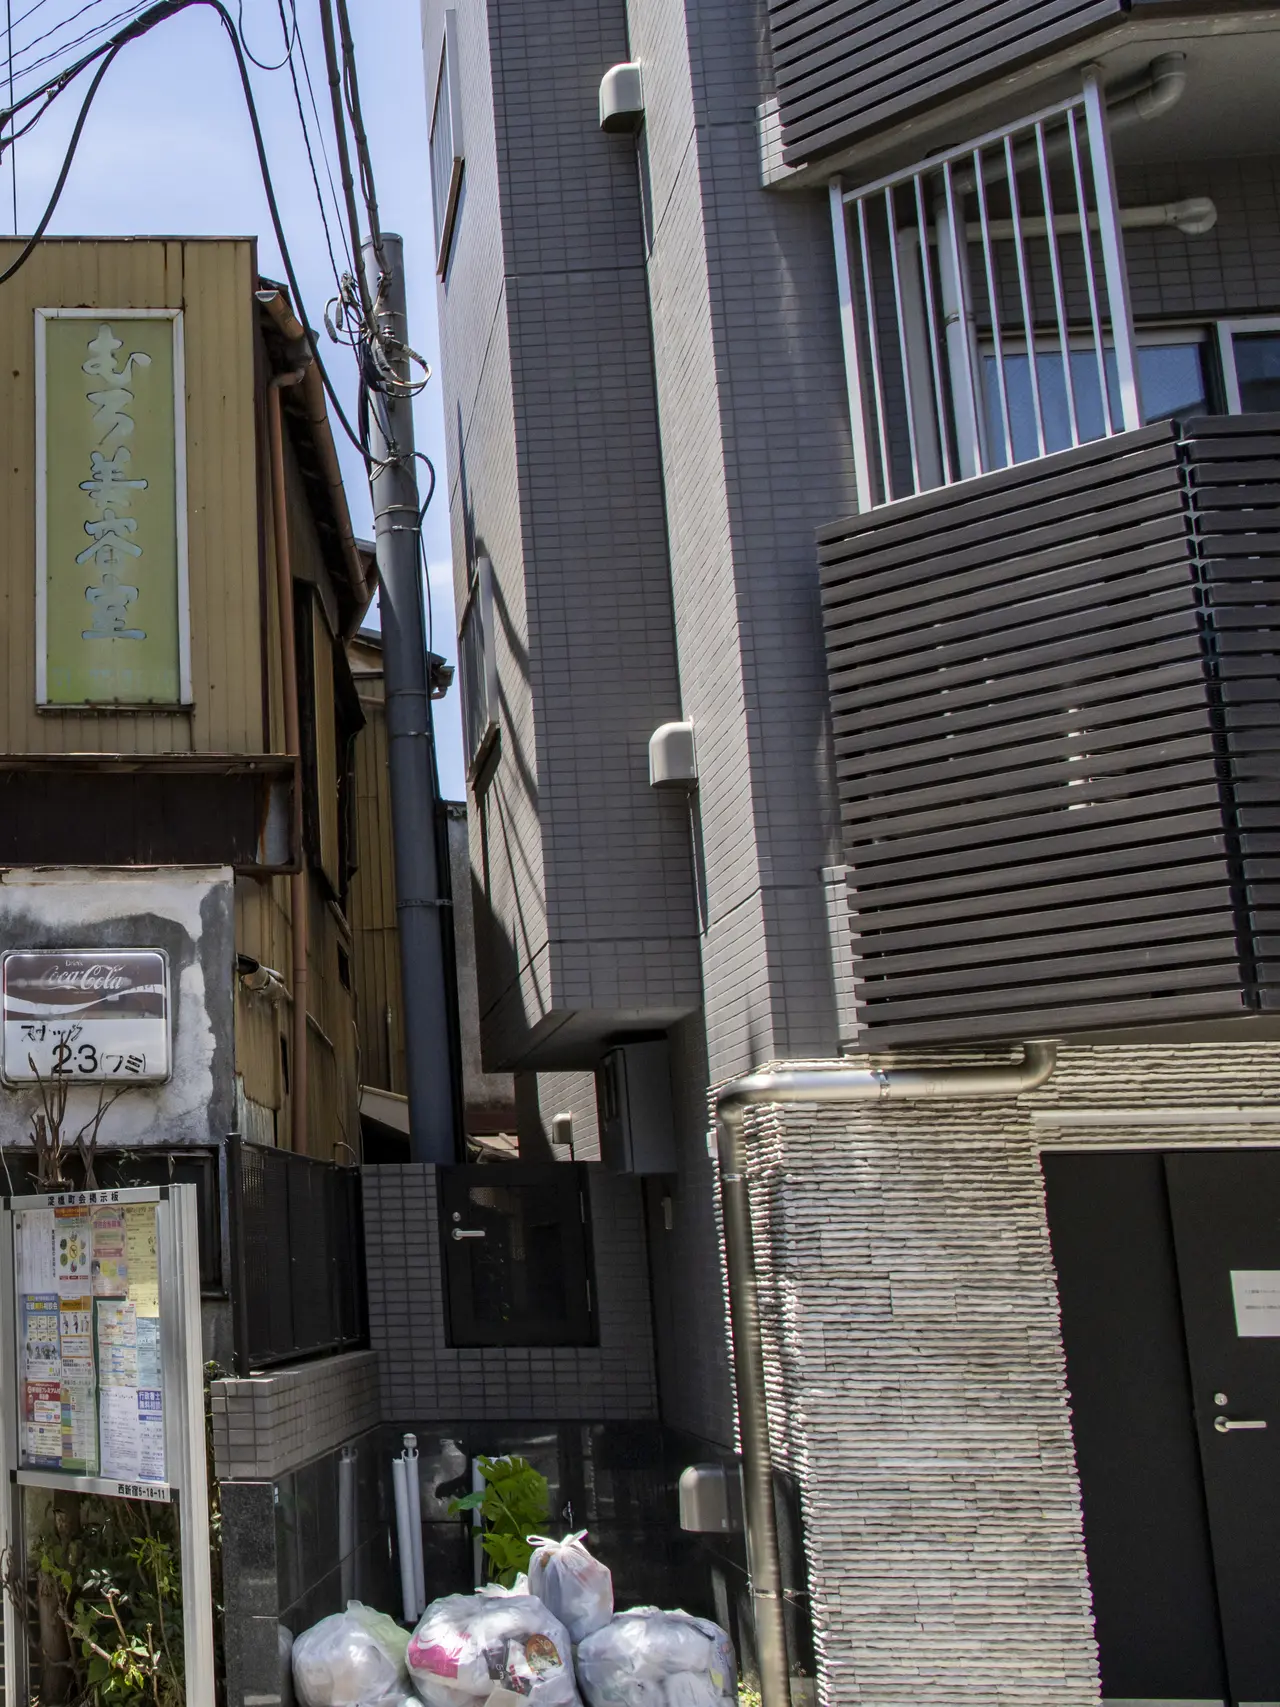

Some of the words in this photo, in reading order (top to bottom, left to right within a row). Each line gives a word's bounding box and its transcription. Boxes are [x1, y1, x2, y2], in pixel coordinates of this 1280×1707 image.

[41, 964, 125, 990] Coca-Cola
[47, 1191, 120, 1206] 淀橋町会掲示板
[118, 1483, 165, 1499] 西新宿5-18-11
